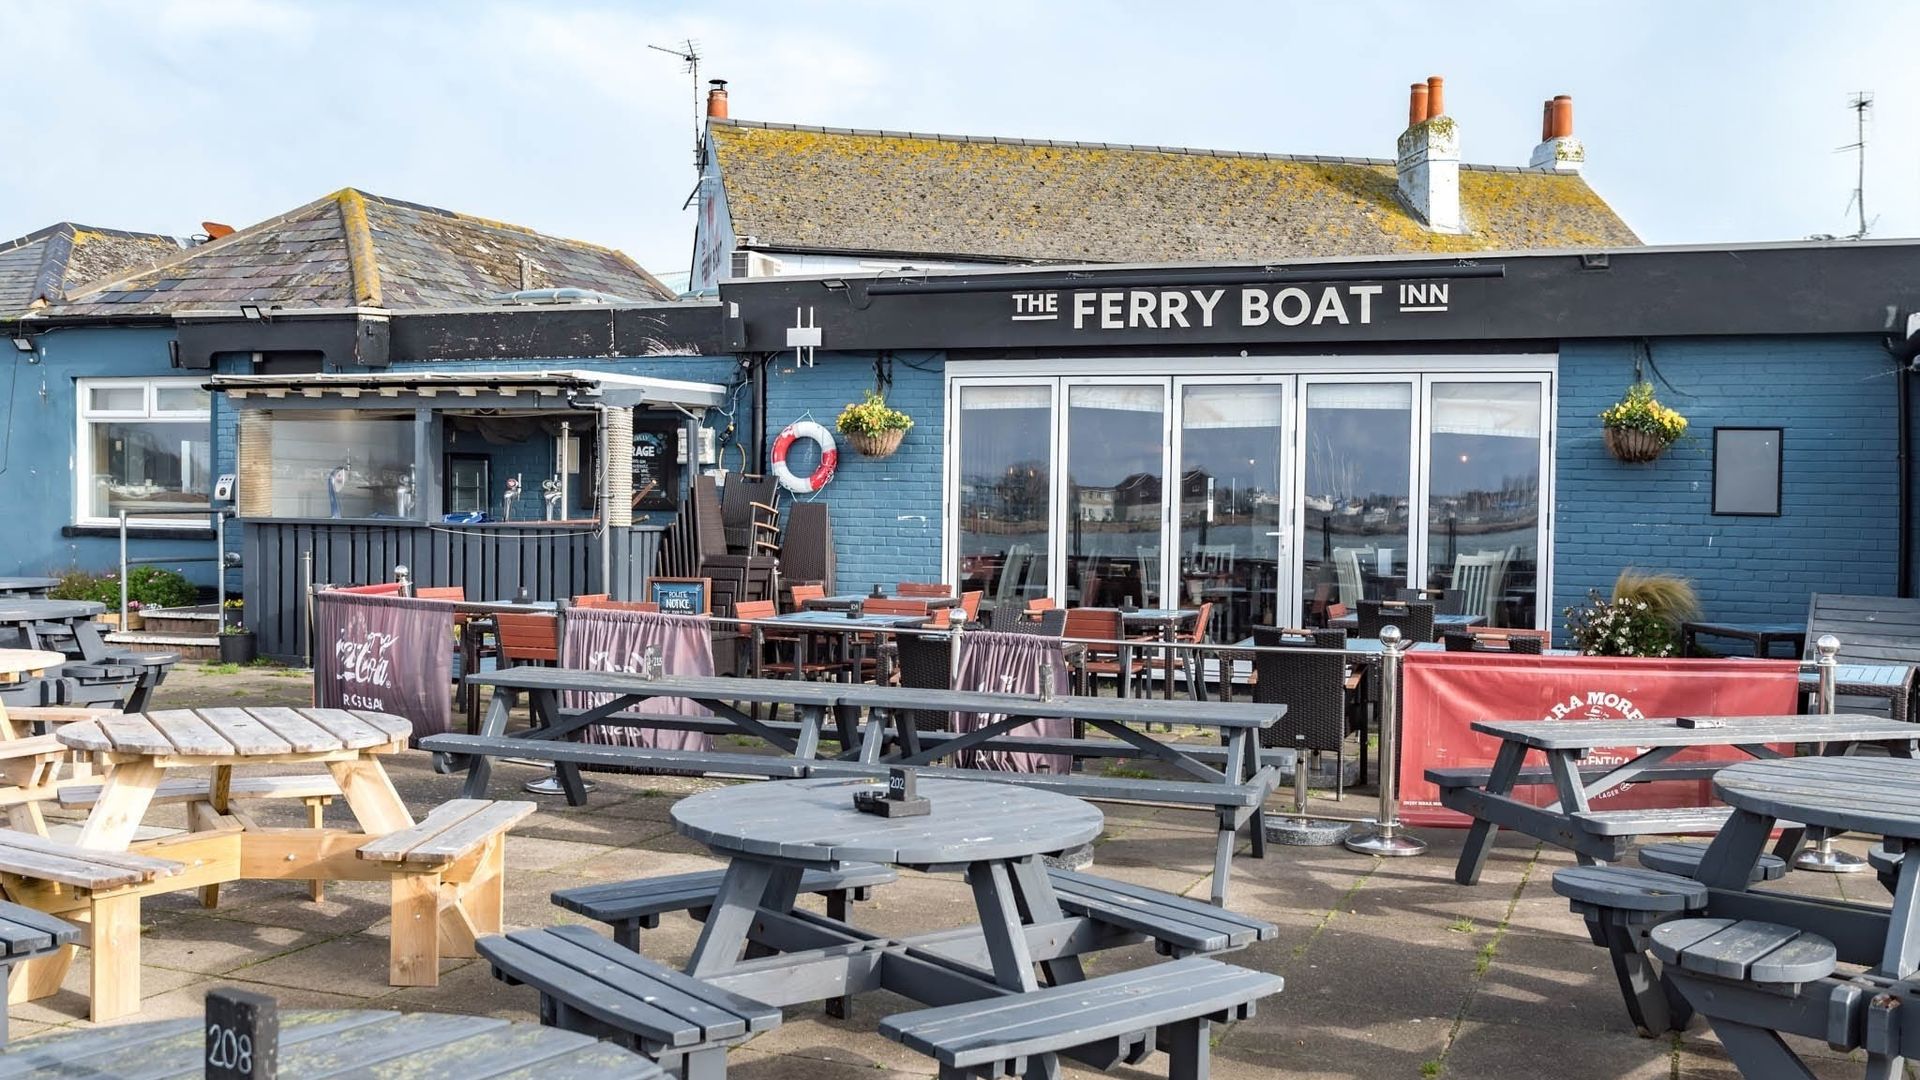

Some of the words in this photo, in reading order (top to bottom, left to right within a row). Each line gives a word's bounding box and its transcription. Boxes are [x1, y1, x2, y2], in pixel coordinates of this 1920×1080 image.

[1012, 293, 1058, 313] THE
[1073, 289, 1226, 329] FERRY
[1241, 285, 1383, 326] BOAT
[1400, 283, 1449, 304] INN
[666, 599, 690, 609] NOTICE
[890, 776, 905, 790] 202
[1599, 789, 1619, 799] LAGER
[208, 1023, 252, 1075] 208
